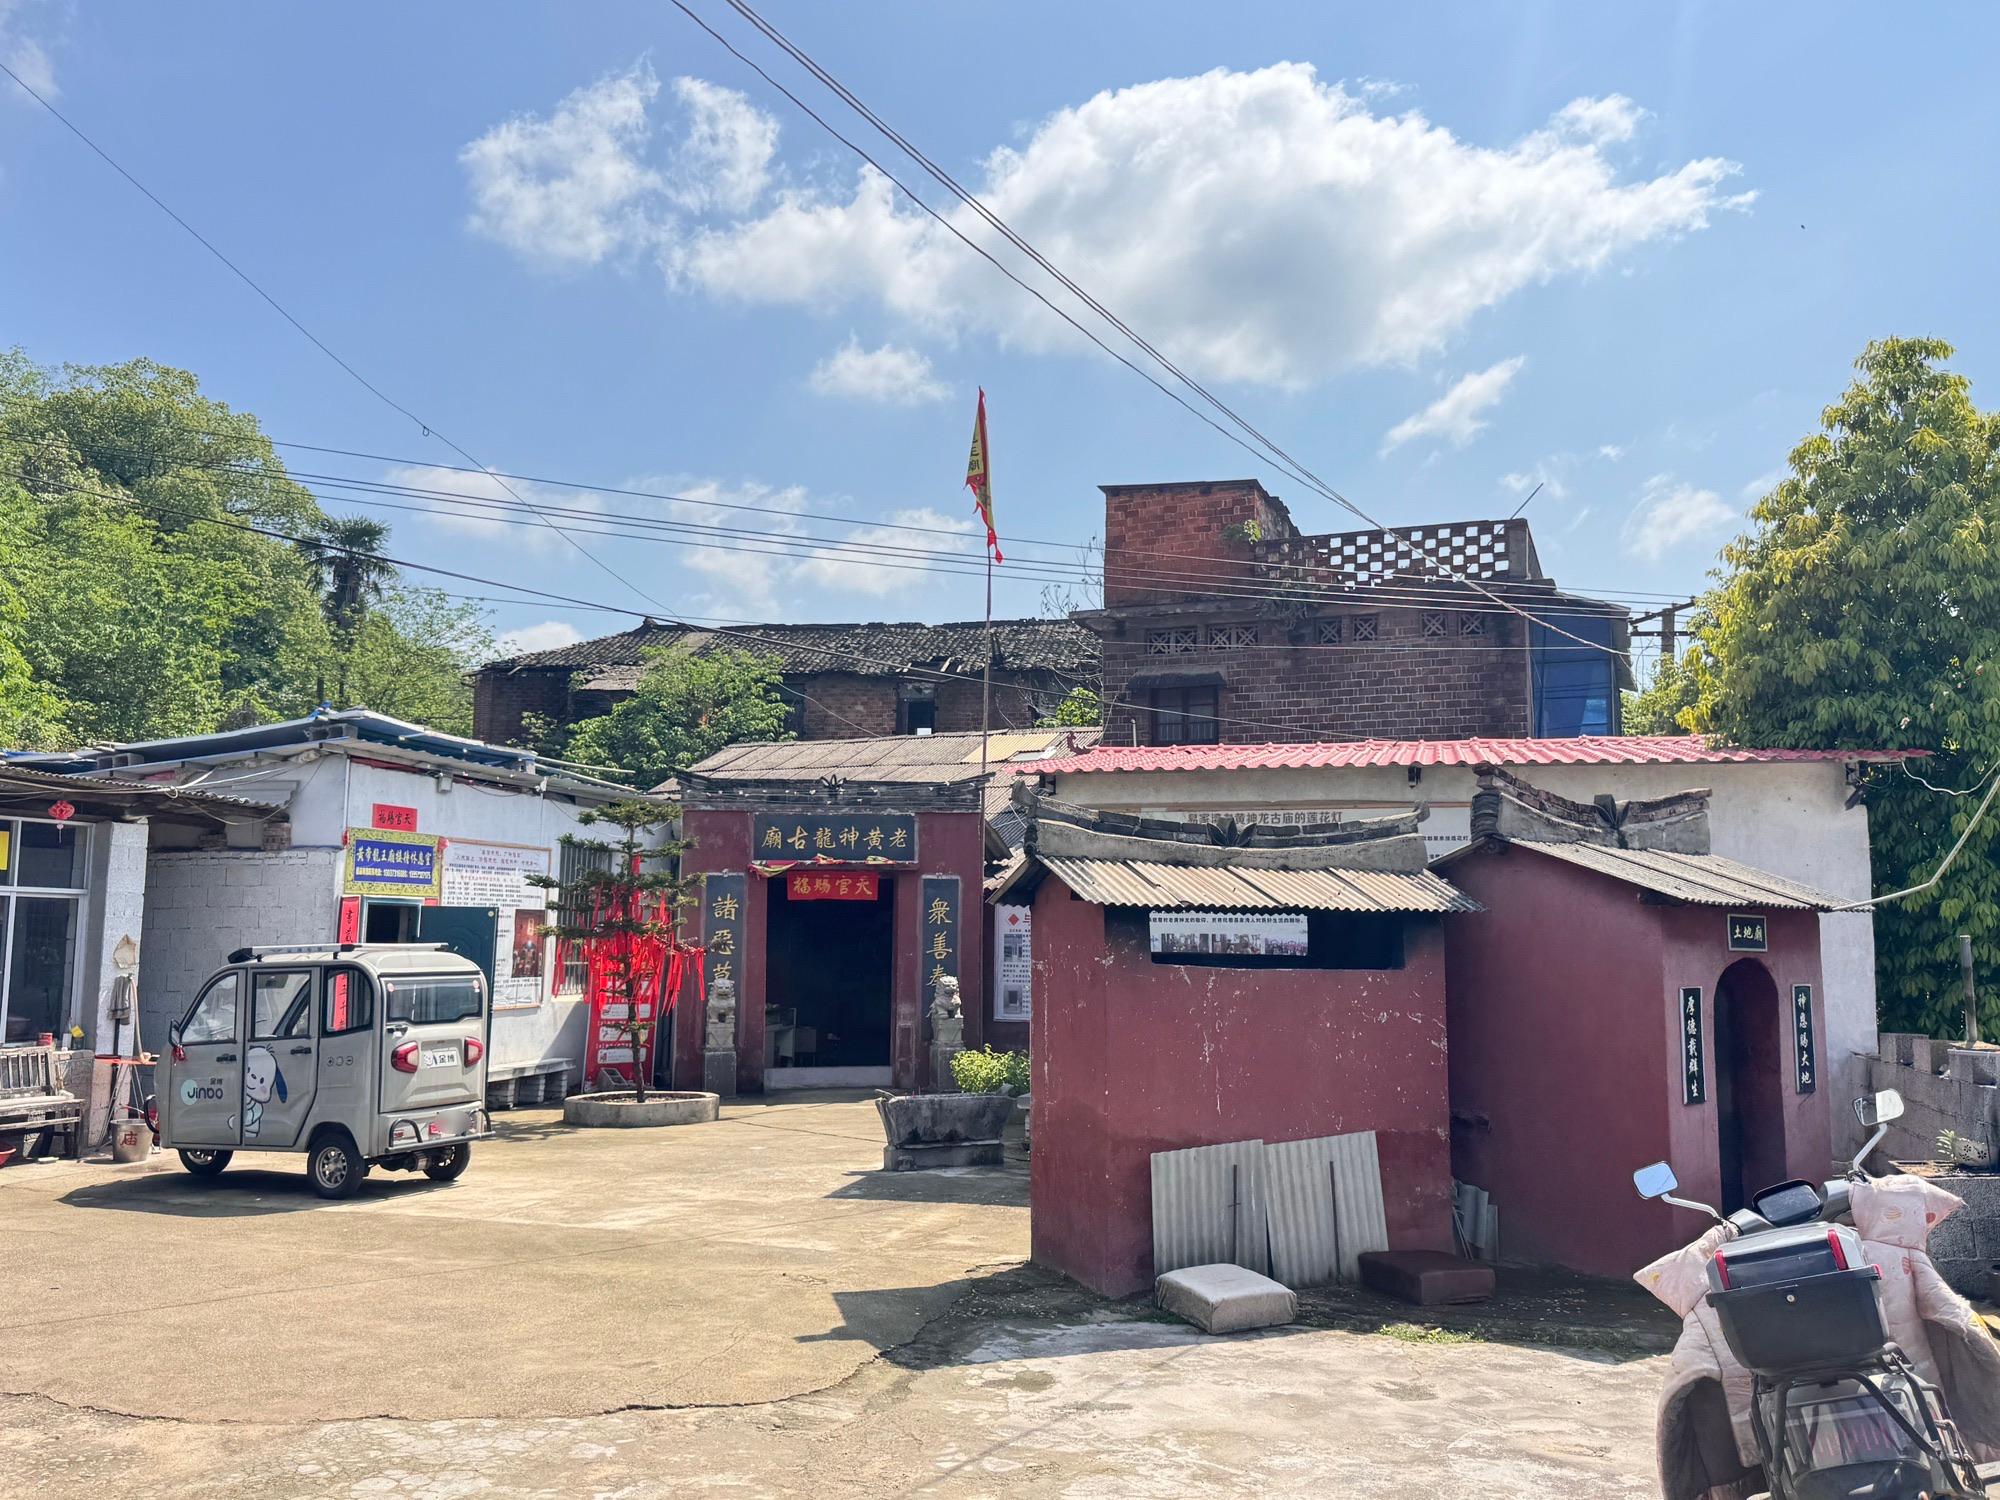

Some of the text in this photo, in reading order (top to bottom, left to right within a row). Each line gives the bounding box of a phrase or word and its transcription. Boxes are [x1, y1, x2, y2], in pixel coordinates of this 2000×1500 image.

[1188, 811, 1343, 826] 易家湾黄神龙古庙的莲花灯
